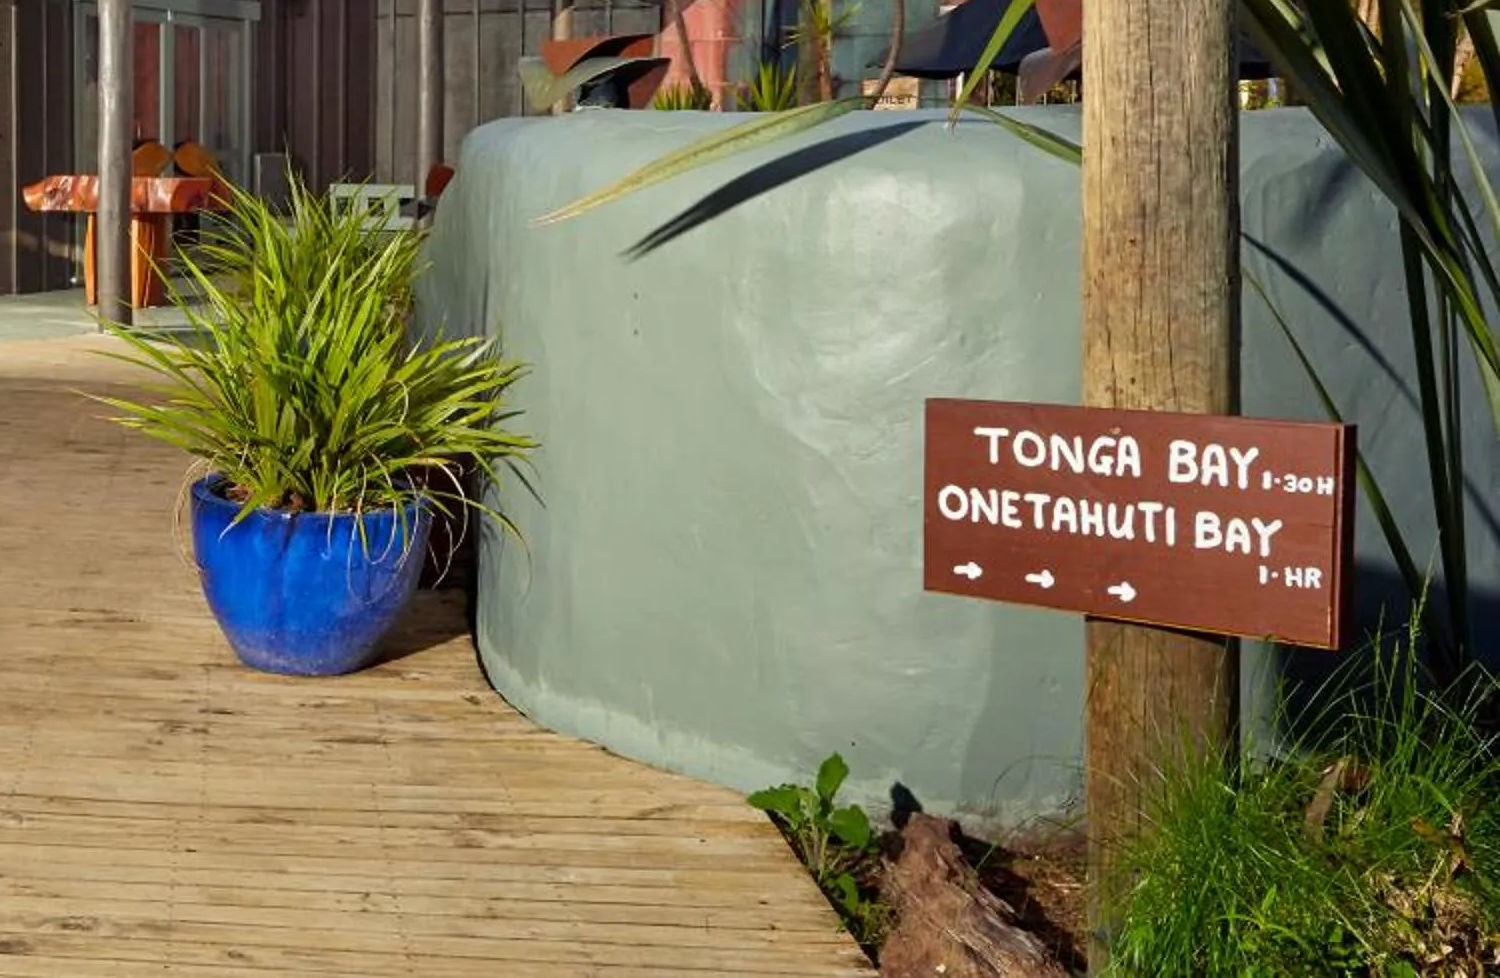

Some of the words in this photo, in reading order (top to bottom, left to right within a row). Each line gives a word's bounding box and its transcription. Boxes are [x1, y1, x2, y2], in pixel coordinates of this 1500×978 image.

[973, 426, 1141, 478] TONGA
[1168, 439, 1260, 490] BAY
[937, 484, 1176, 547] ONETAHUTI
[1194, 510, 1284, 558] BAY
